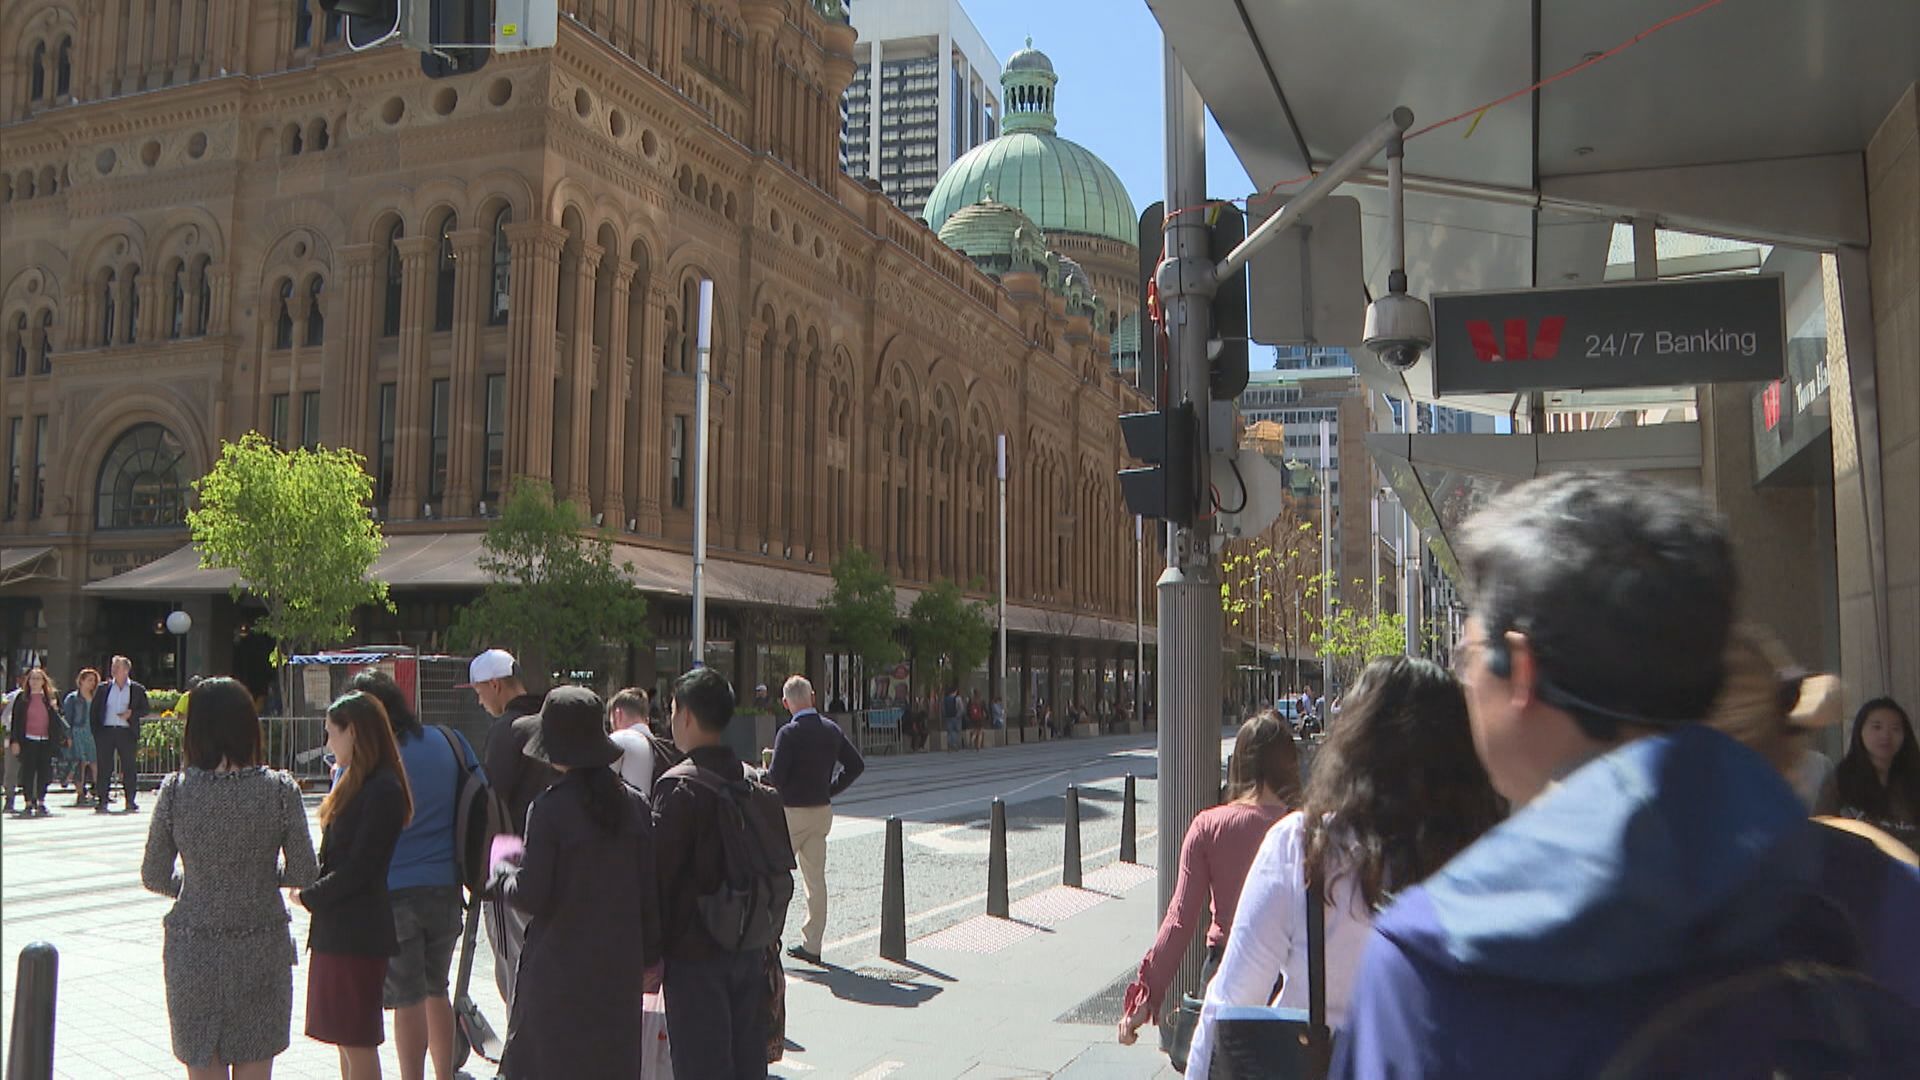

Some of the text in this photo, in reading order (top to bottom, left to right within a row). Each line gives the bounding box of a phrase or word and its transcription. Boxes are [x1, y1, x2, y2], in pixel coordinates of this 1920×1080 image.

[1585, 332, 1644, 358] 24/7
[1655, 328, 1757, 356] Banking
[1795, 379, 1816, 414] Town
[1816, 354, 1831, 395] Hal
